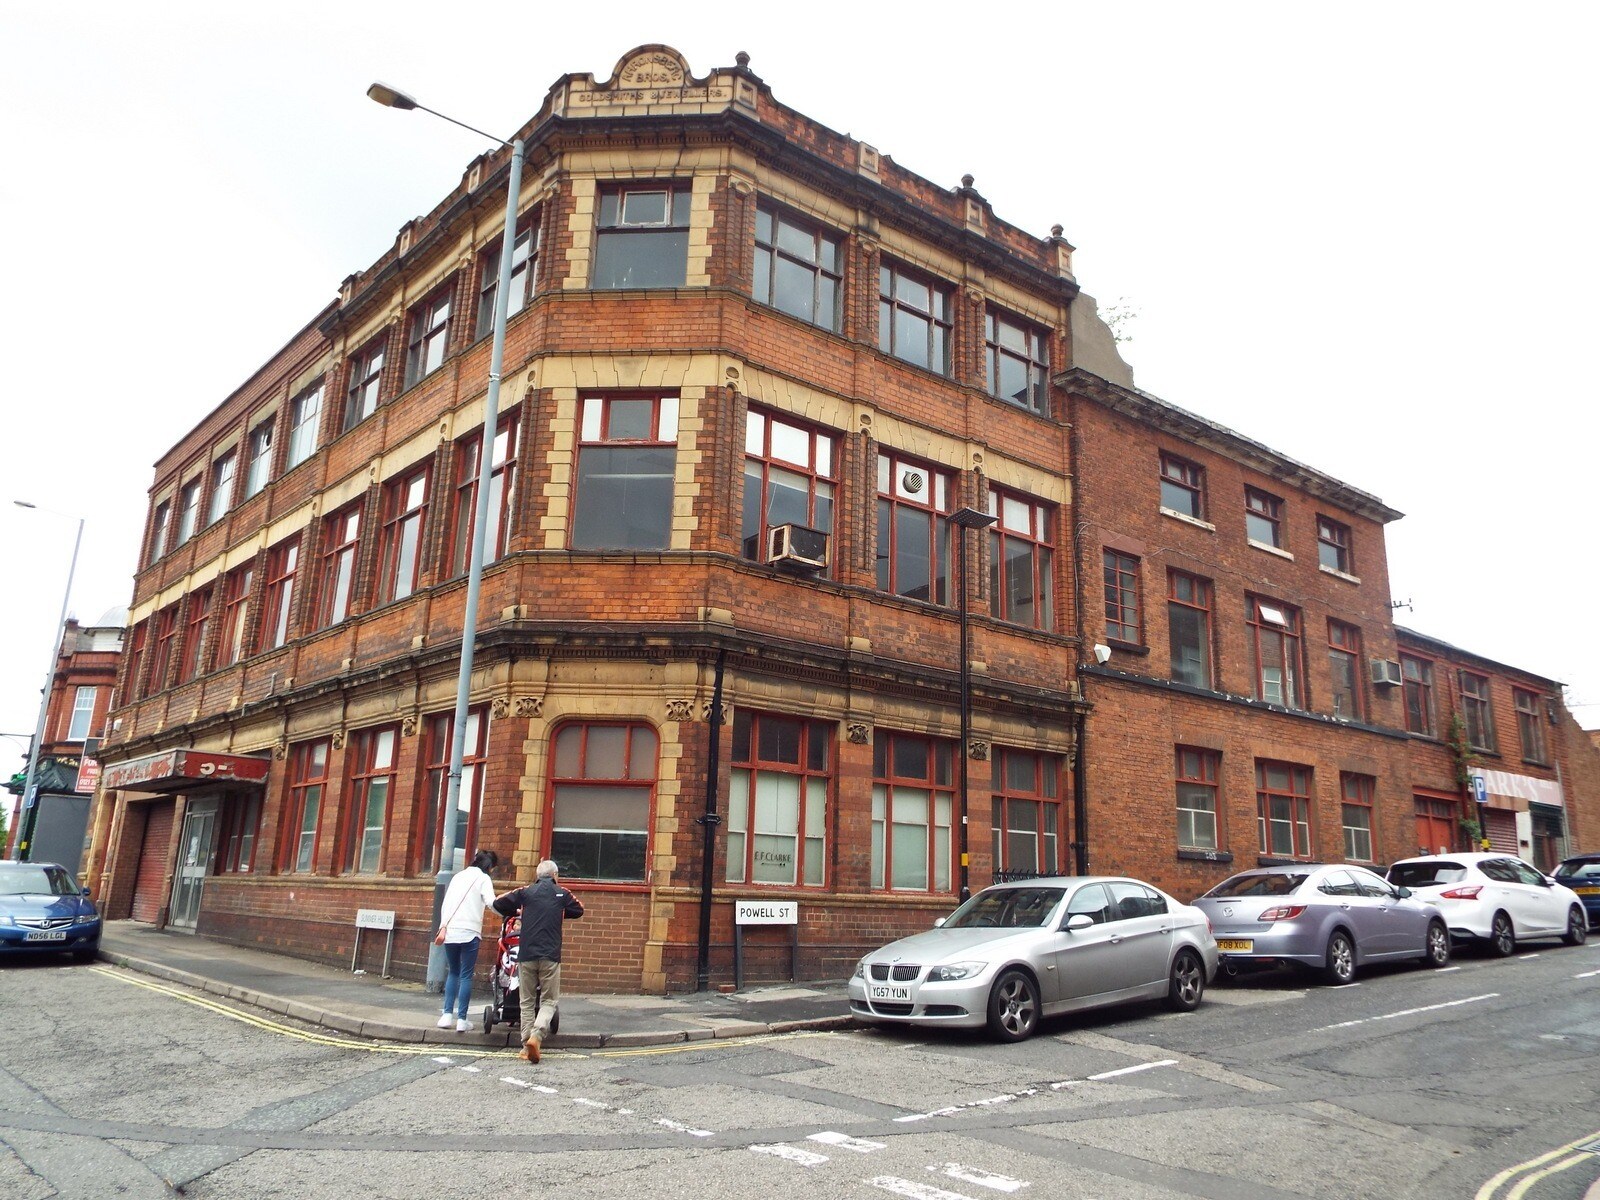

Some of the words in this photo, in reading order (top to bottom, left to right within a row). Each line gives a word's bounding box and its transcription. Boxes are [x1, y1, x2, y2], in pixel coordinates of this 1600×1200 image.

[579, 90, 644, 102] GOLDSMITHS
[650, 91, 656, 100] &
[740, 908, 774, 917] POWELL
[779, 908, 789, 917] ST
[28, 932, 49, 940] ND56
[50, 932, 65, 940] LGL
[872, 986, 890, 997] YG57
[891, 987, 908, 998] YUN
